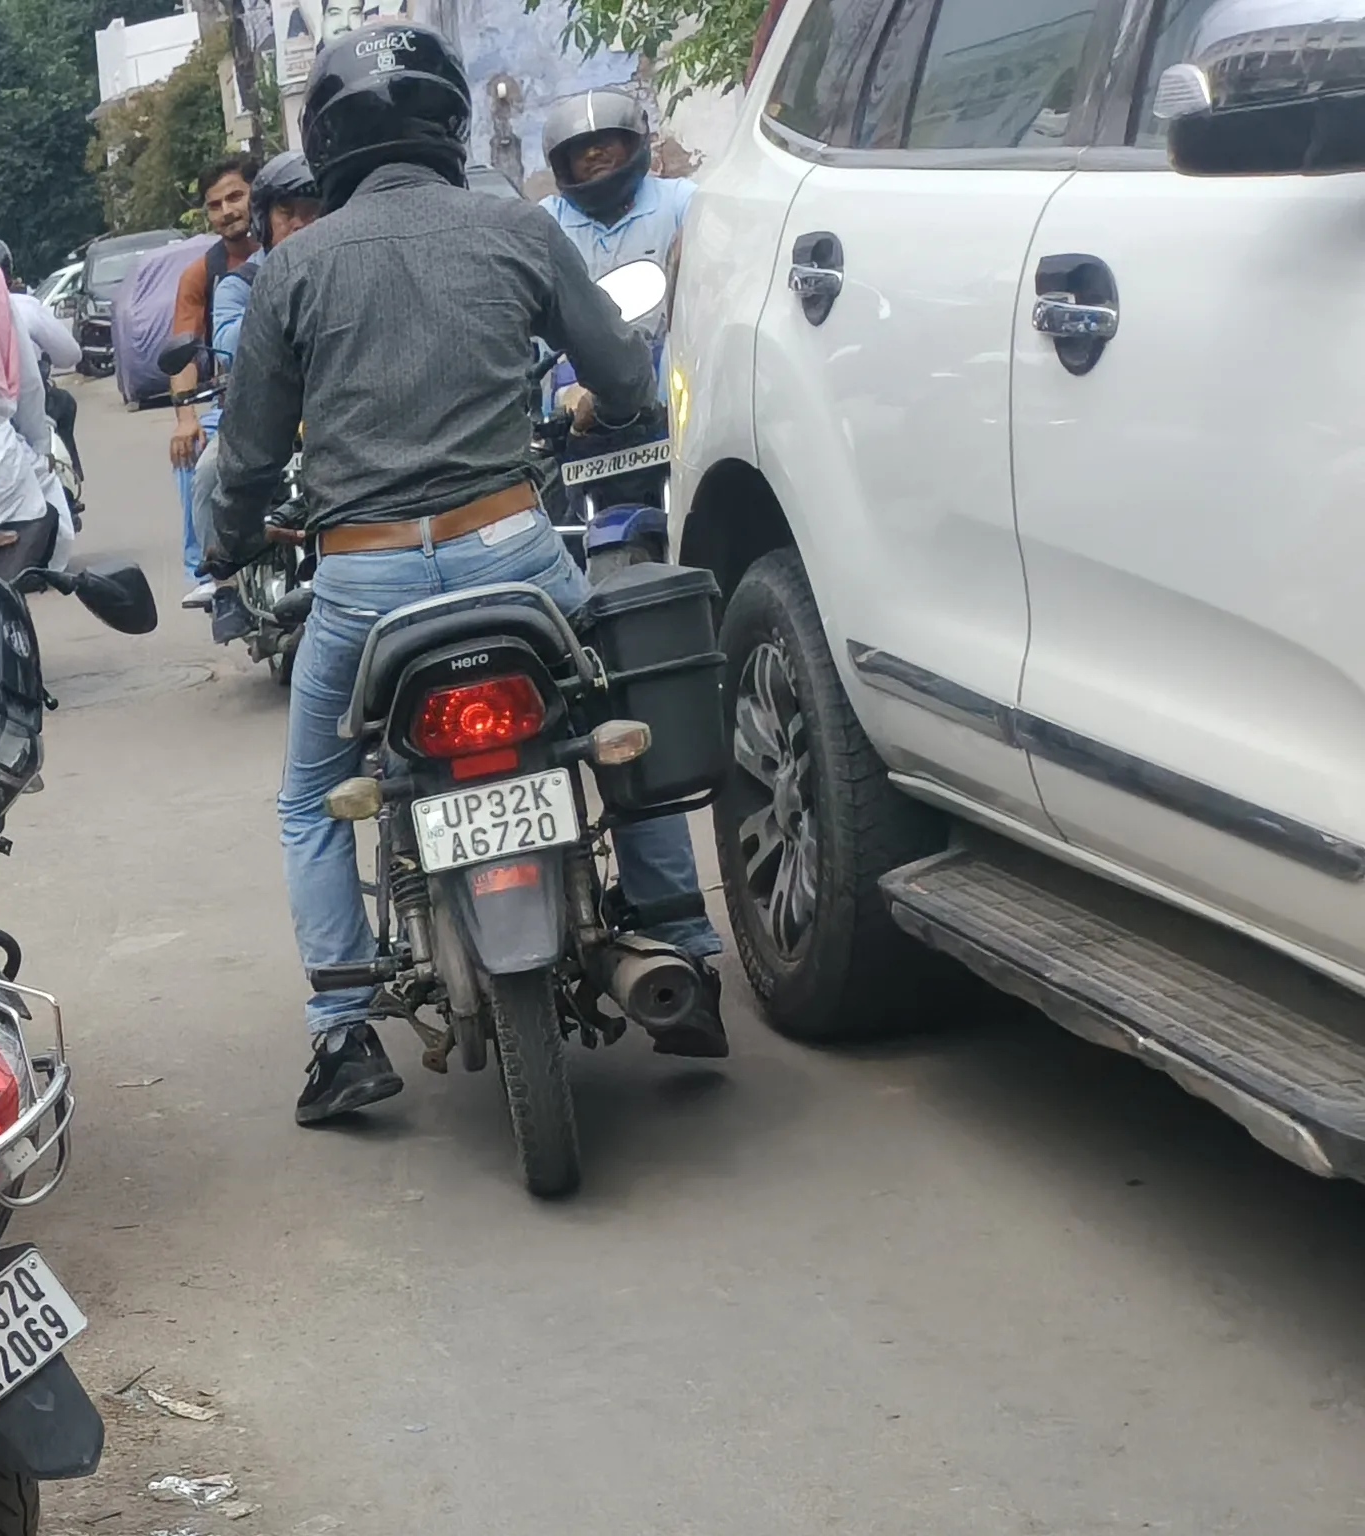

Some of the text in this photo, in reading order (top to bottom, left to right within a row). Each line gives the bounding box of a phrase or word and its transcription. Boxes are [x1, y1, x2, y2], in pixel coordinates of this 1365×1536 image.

[450, 653, 489, 671] Hero
[441, 778, 553, 829] UP32K
[451, 812, 557, 863] A6720
